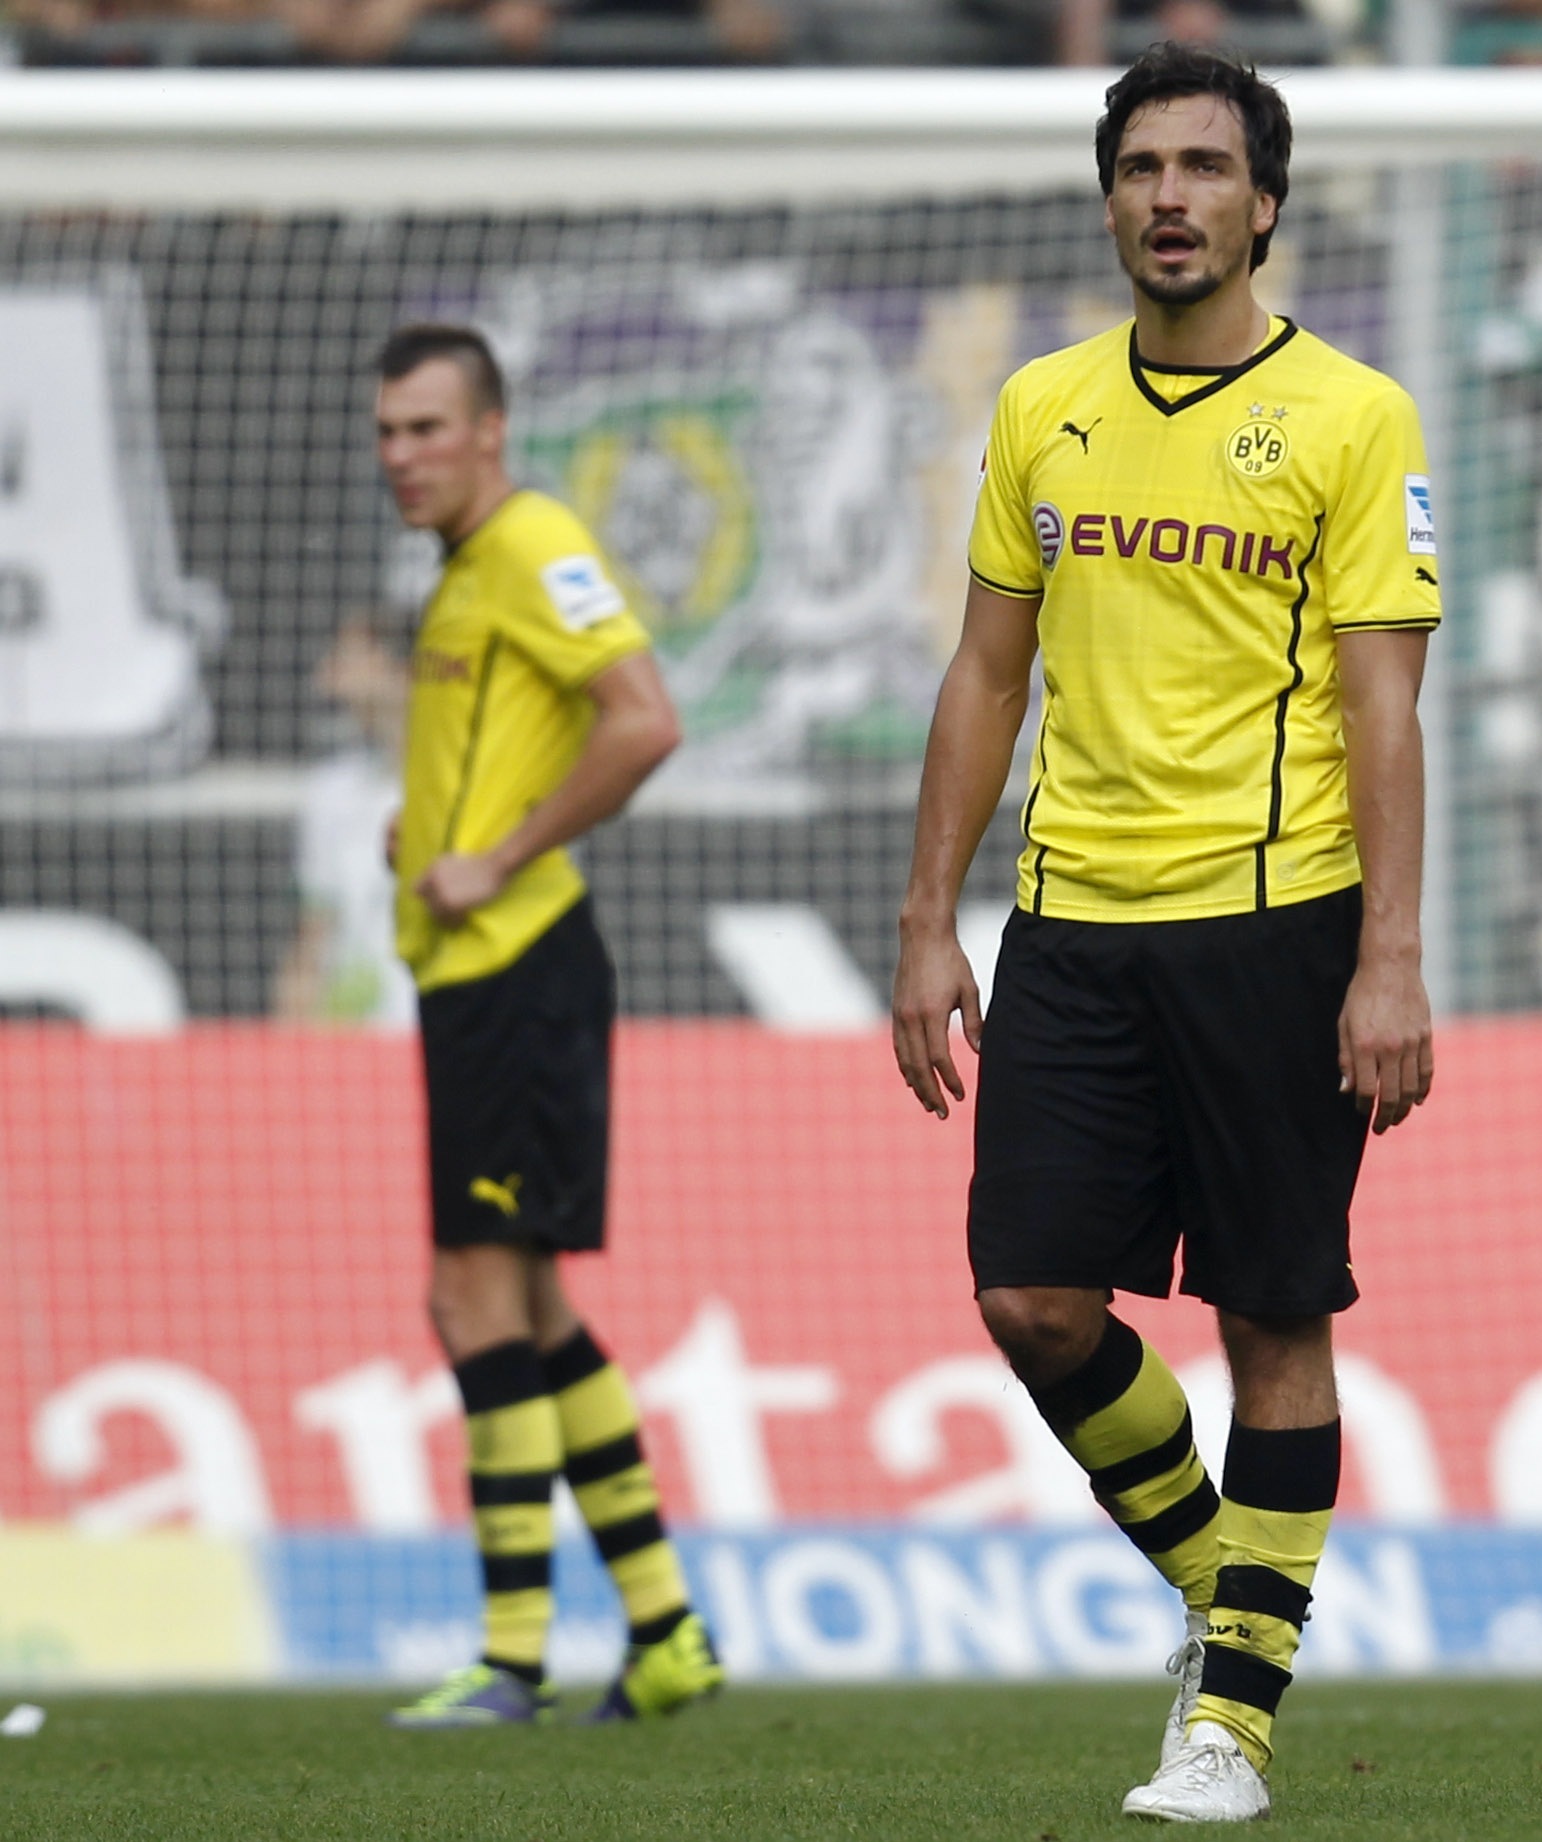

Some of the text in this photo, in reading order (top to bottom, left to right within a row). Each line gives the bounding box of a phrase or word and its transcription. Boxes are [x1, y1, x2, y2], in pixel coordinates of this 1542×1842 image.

[1234, 426, 1282, 463] BVB
[1244, 459, 1263, 473] 09
[1071, 513, 1294, 580] EVONIK
[700, 1536, 1440, 1678] JONGN
